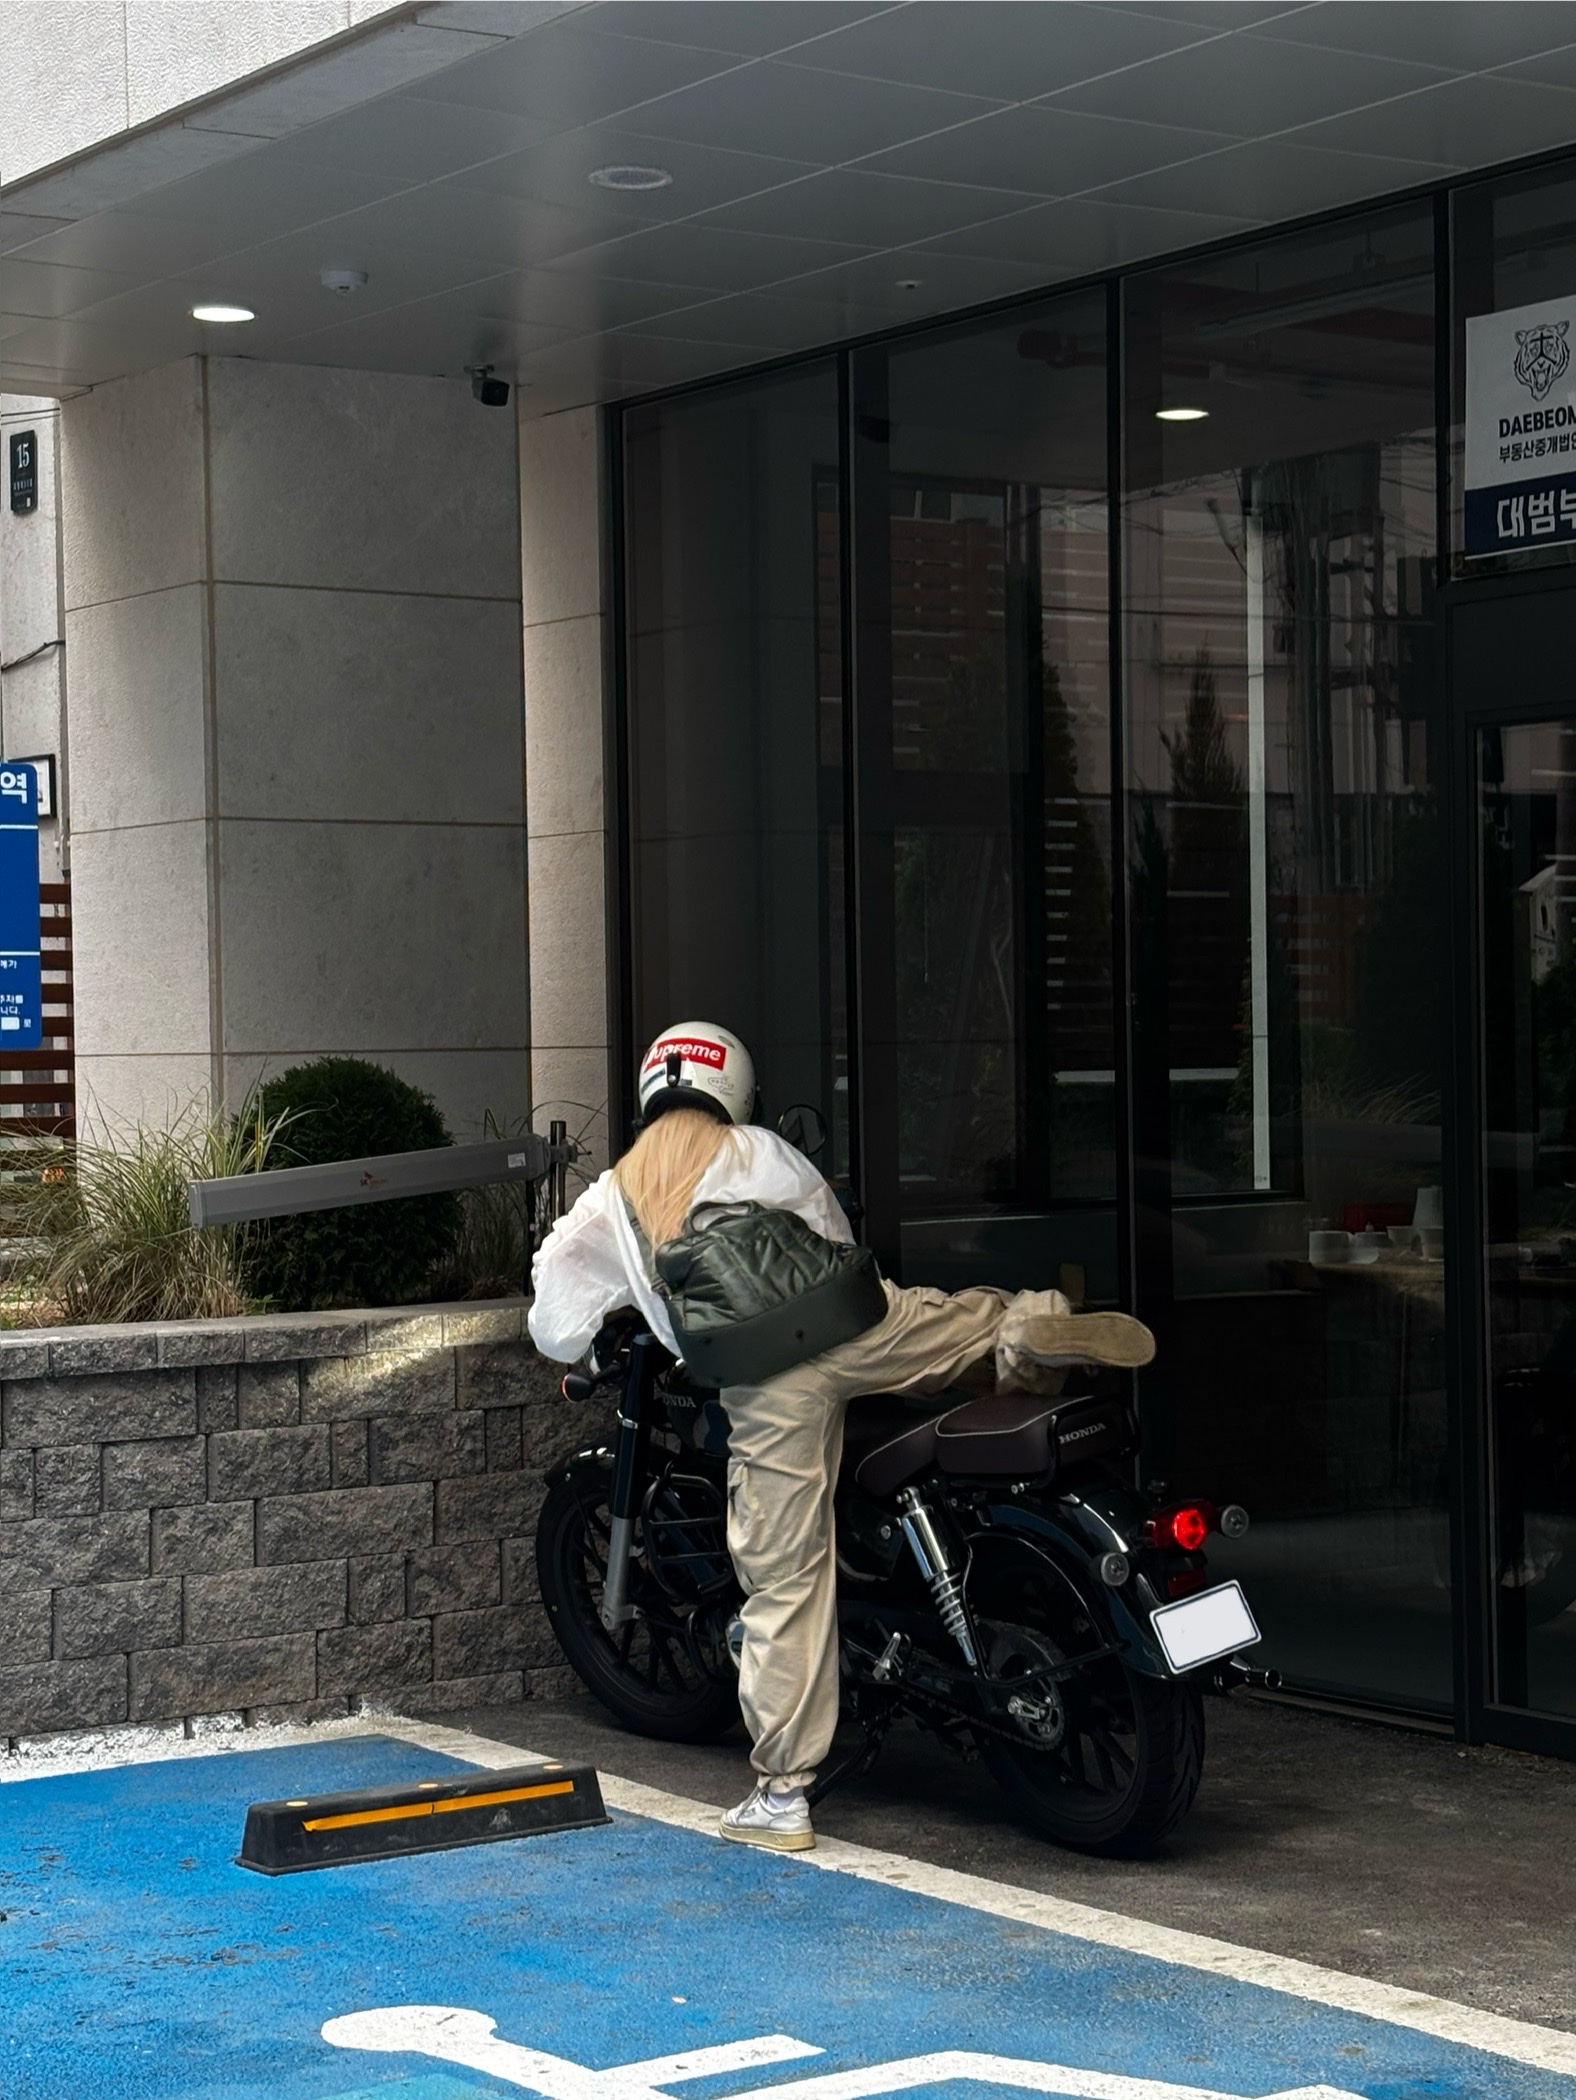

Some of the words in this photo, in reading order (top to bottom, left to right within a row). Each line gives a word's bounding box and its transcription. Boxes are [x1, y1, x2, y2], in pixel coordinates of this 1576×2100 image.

[16, 442, 30, 469] 15
[0, 771, 27, 804] 역
[657, 1393, 697, 1408] ONDA
[1058, 1422, 1107, 1444] HONDA
